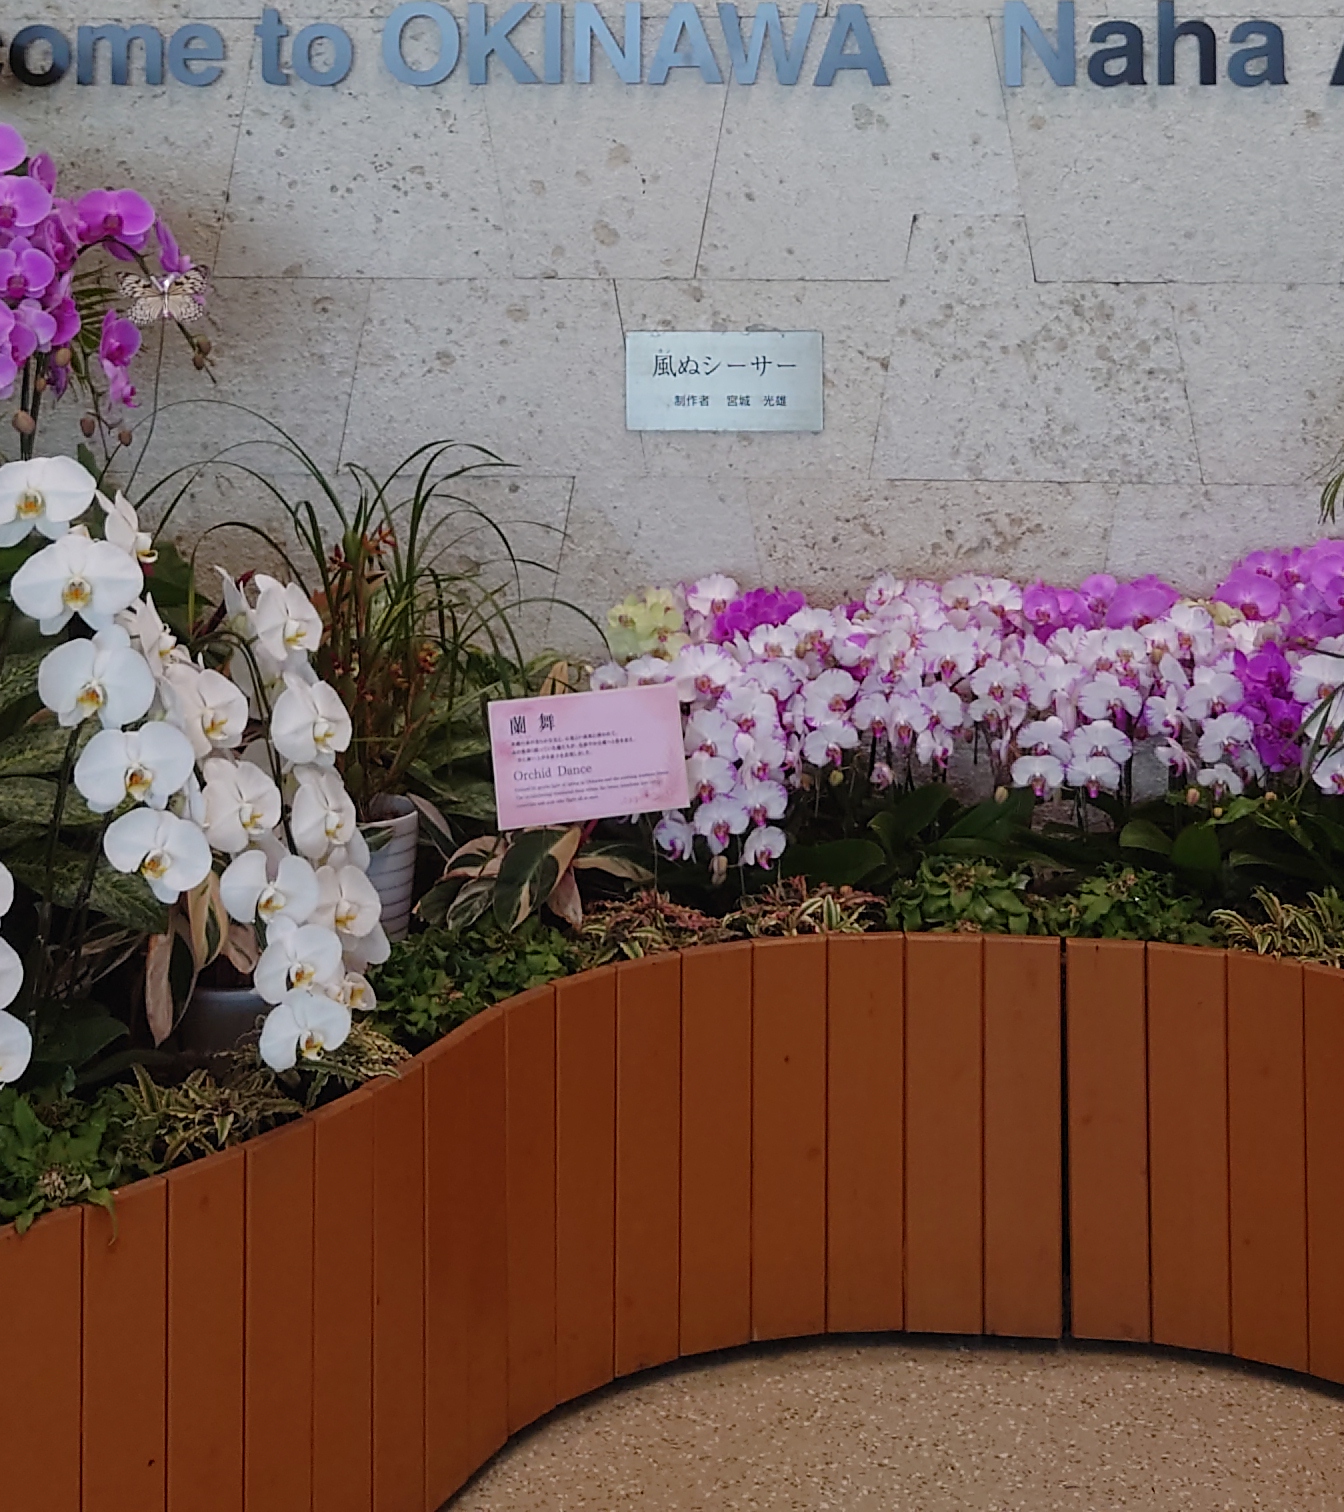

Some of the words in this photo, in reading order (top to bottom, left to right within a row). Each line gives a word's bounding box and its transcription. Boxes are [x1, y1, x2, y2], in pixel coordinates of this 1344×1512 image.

[257, 8, 354, 87] to
[379, 0, 891, 87] OKINAWA
[652, 354, 797, 377] 風ぬシーサー
[674, 394, 709, 406] 制作者
[726, 394, 750, 406] 宮城
[513, 766, 552, 781] Orchid
[557, 763, 593, 777] Dance
